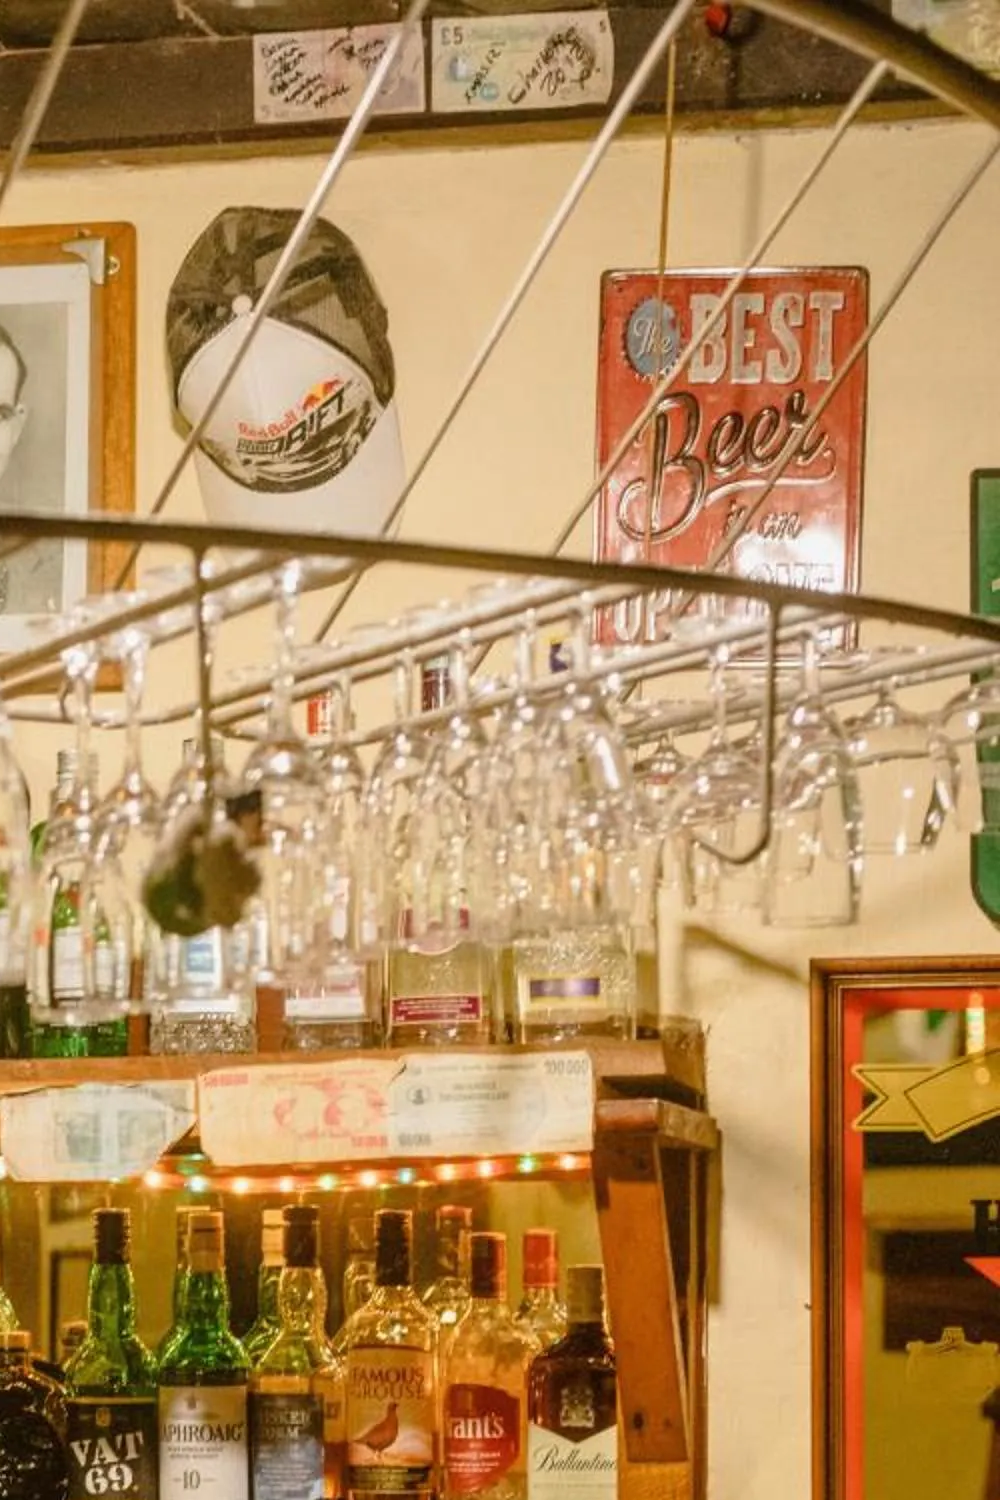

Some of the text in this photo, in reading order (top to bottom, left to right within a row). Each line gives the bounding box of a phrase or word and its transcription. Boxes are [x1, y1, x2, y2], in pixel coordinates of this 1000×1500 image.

[688, 291, 845, 385] BEST
[616, 390, 838, 545] Beer
[162, 1421, 246, 1443] APHROAIG
[450, 1412, 505, 1439] rant's
[69, 1430, 144, 1468] VAT
[183, 1469, 201, 1491] 10
